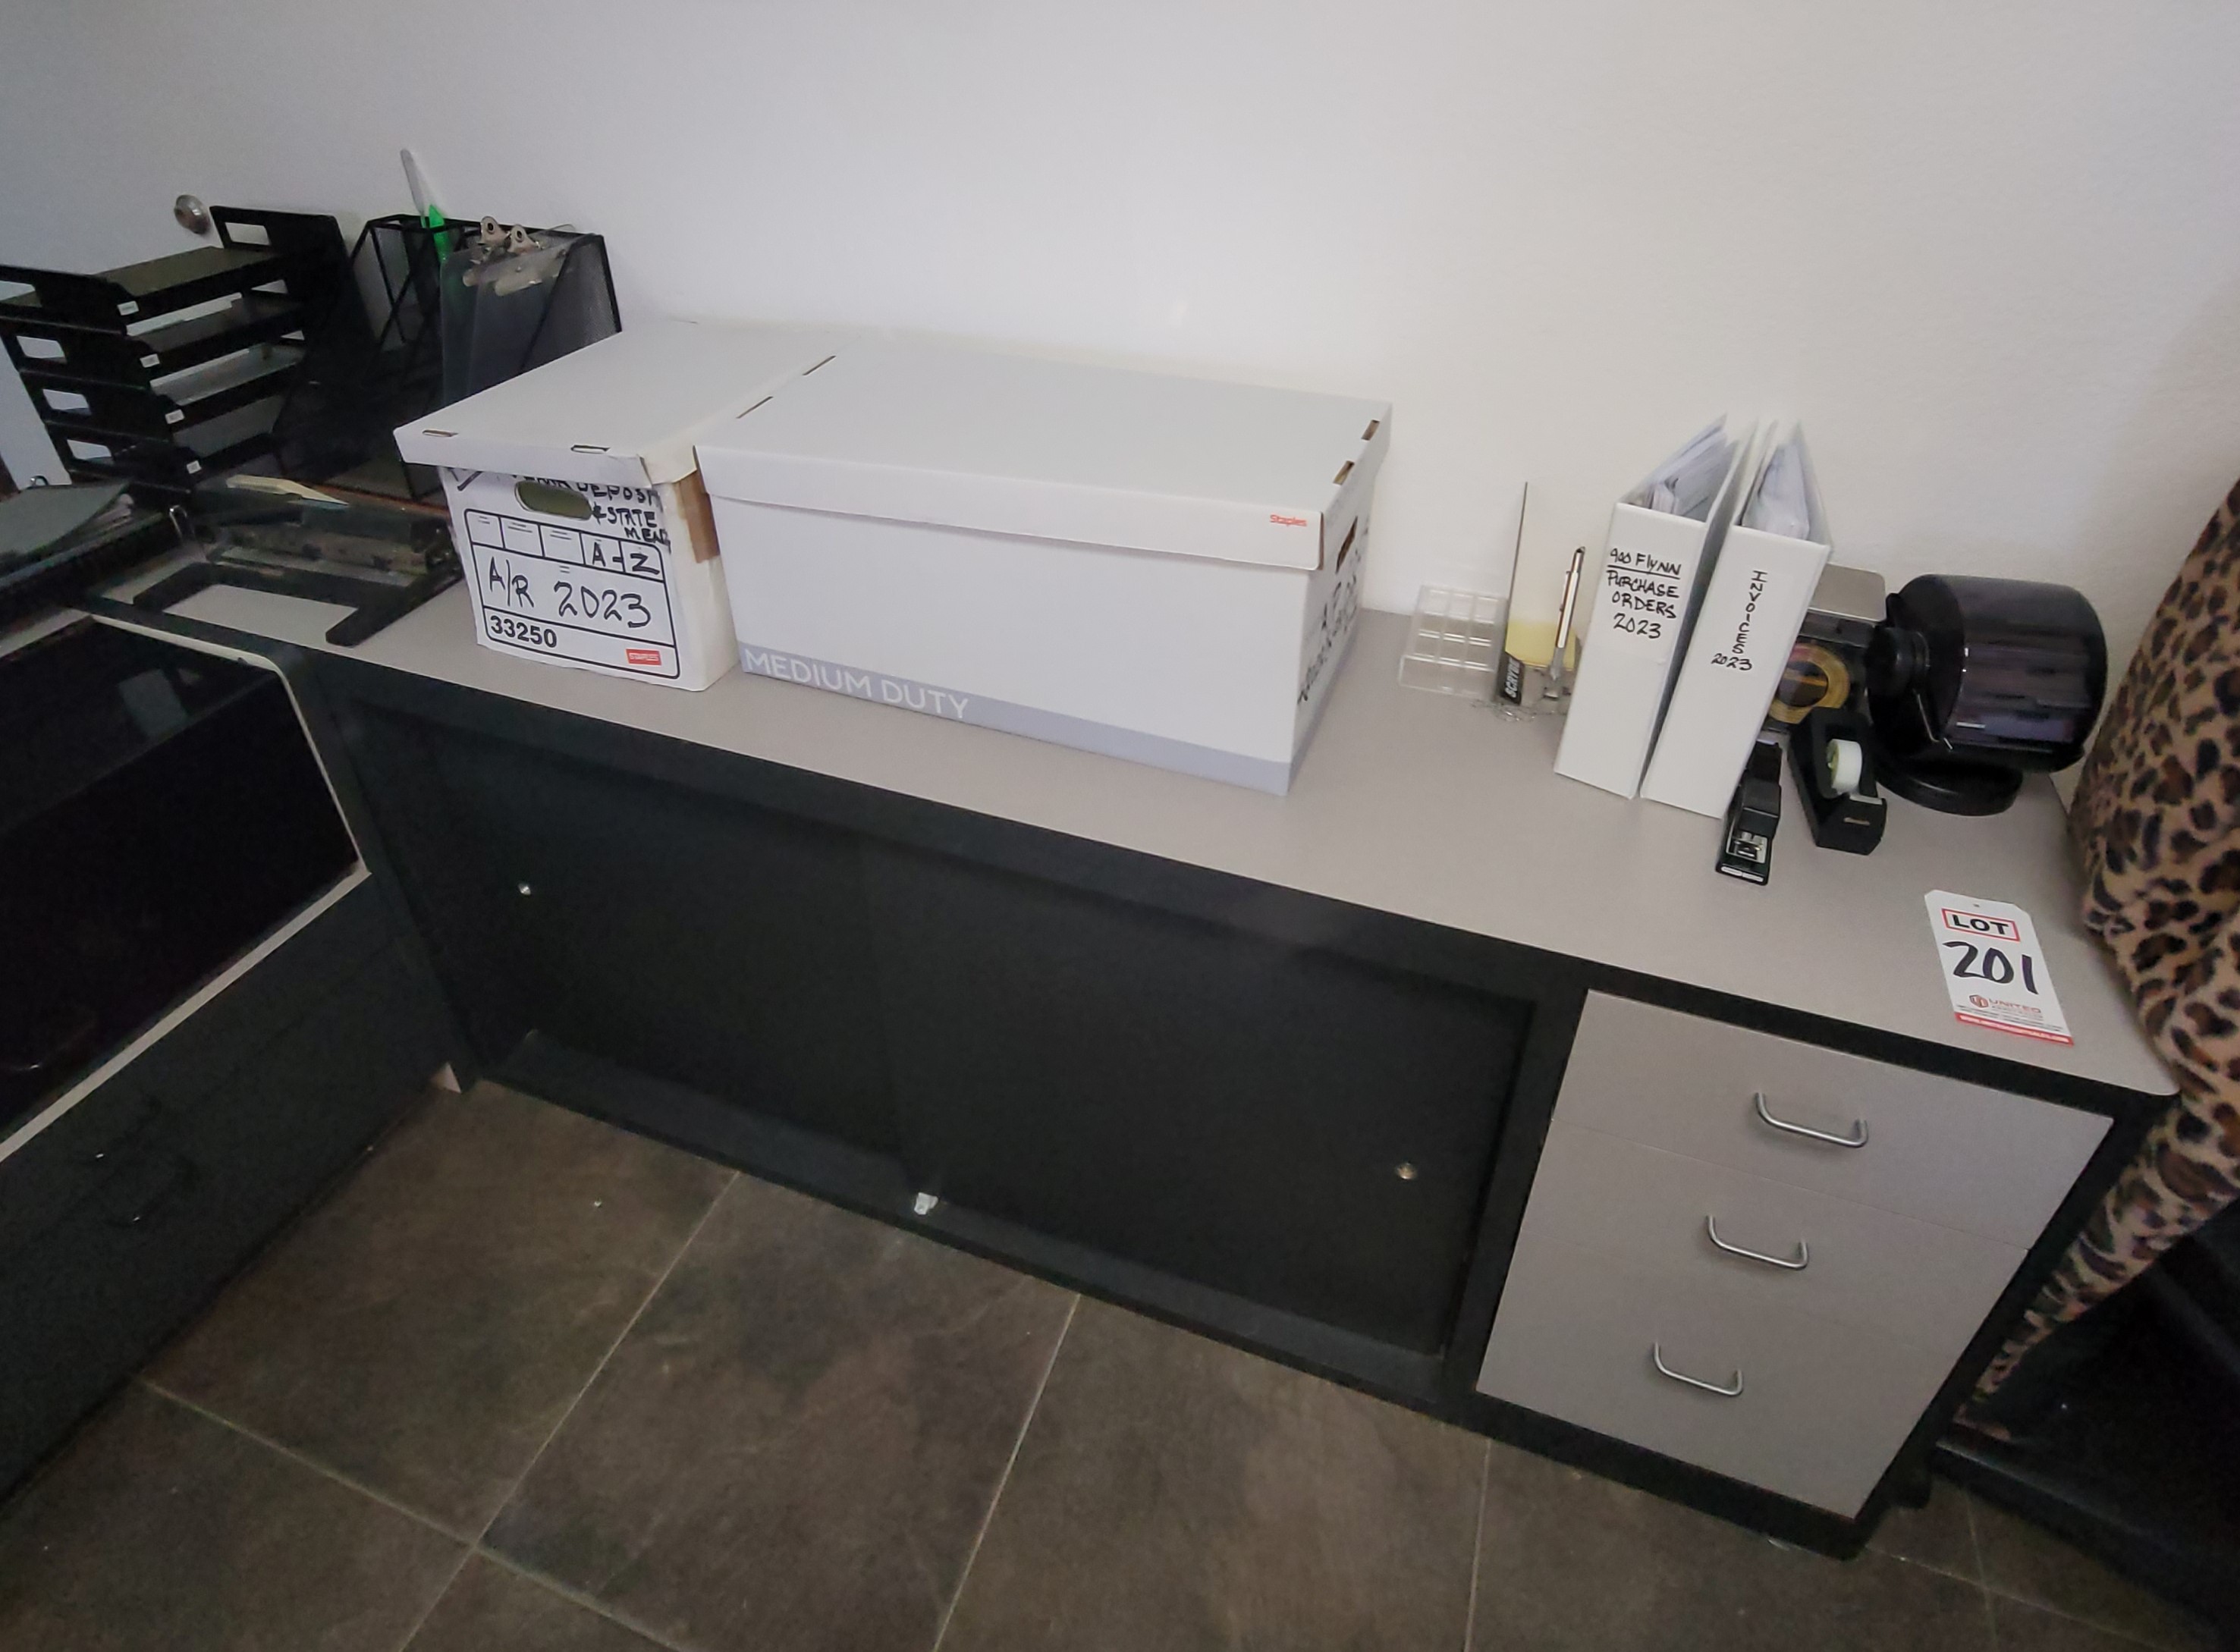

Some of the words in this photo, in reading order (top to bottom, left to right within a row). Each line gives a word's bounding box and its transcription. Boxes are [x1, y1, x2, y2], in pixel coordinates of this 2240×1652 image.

[608, 507, 657, 528] STATE
[490, 556, 534, 608] A/R
[554, 581, 651, 628] 2023
[1607, 570, 1679, 598] PURCHASE
[1612, 591, 1676, 619] ORDERS
[1732, 570, 1767, 654] INVOICES
[490, 615, 557, 648] 33250
[1613, 613, 1661, 639] 2023
[1711, 653, 1752, 671] 2023
[745, 649, 872, 698] MEDIUM
[881, 679, 969, 718] DUTY
[1953, 915, 2009, 935] LOT
[1943, 941, 2038, 995] 201
